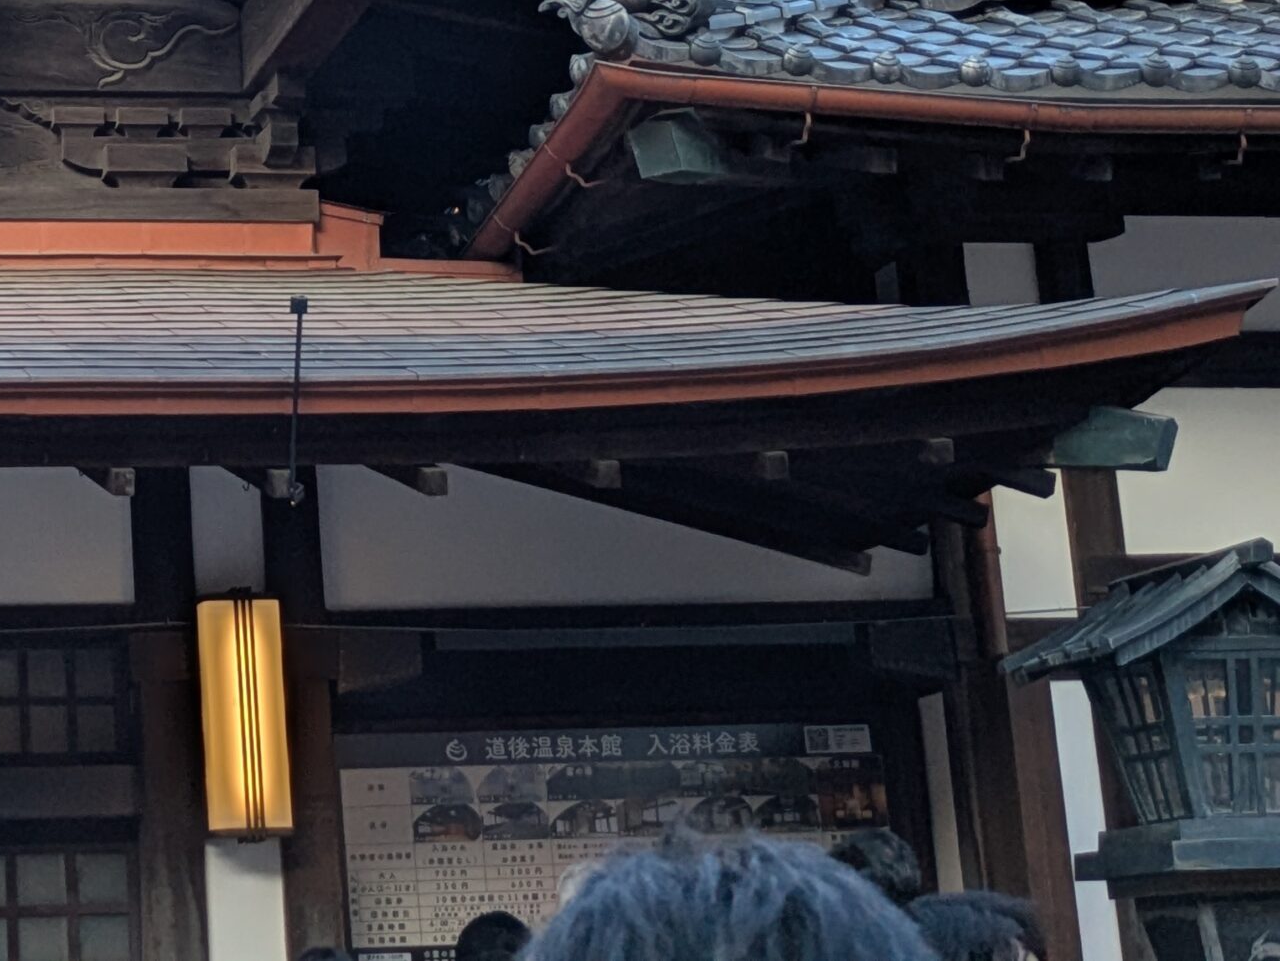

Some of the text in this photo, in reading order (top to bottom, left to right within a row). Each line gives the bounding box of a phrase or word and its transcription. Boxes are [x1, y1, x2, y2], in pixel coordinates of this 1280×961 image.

[485, 731, 761, 760] 道後温泉本館 入浴料金表
